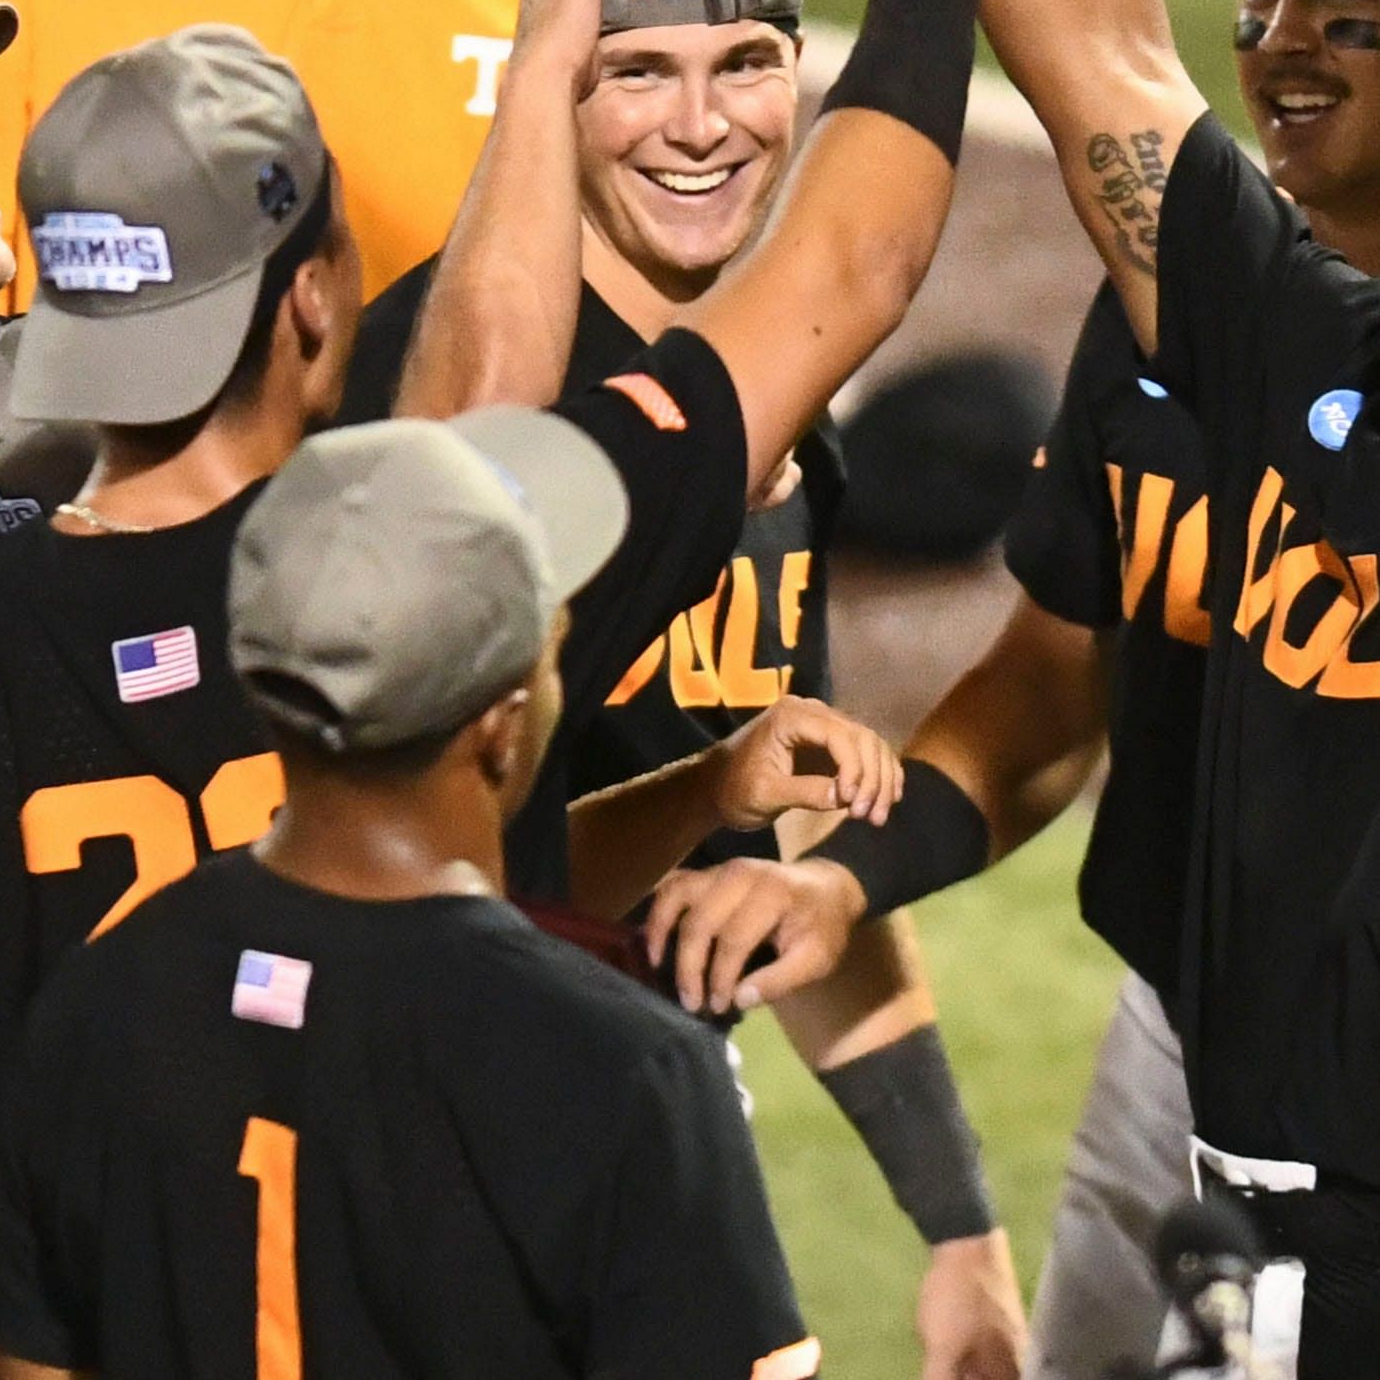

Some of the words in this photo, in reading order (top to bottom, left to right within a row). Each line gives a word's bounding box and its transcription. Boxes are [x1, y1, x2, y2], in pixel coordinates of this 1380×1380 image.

[451, 34, 514, 116] T
[37, 234, 161, 274] CHAMPS
[237, 1117, 304, 1380] 1
